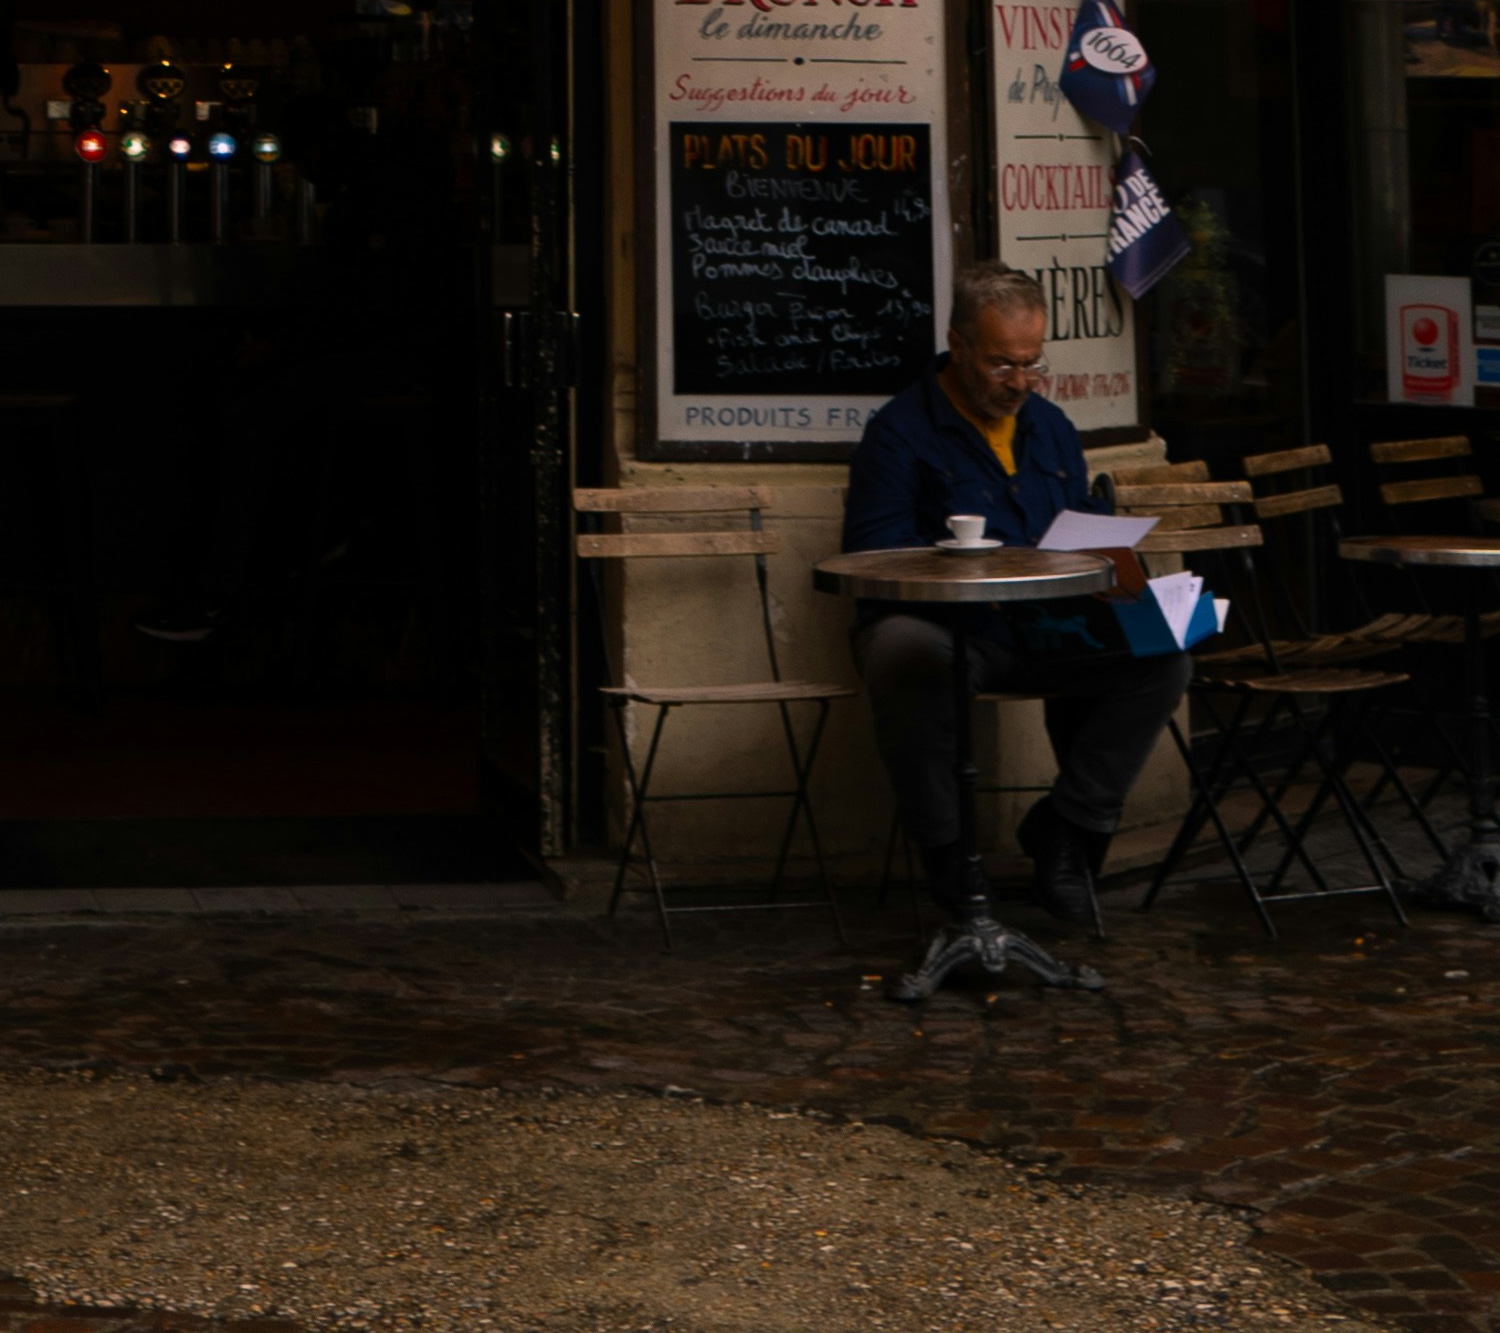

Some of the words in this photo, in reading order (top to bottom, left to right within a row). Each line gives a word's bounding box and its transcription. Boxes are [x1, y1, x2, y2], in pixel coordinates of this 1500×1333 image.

[699, 8, 727, 40] le
[736, 6, 884, 43] dimanche
[1086, 31, 1142, 69] 1664
[669, 73, 805, 113] Suggestions
[811, 81, 837, 103] du
[845, 80, 916, 112] jour
[682, 132, 769, 171] PLATS
[786, 133, 829, 173] DU
[838, 132, 918, 173] JOUR
[1126, 168, 1155, 199] DE
[777, 206, 809, 234] de
[1107, 189, 1170, 263] RANCE
[685, 406, 812, 428] PRODUITS
